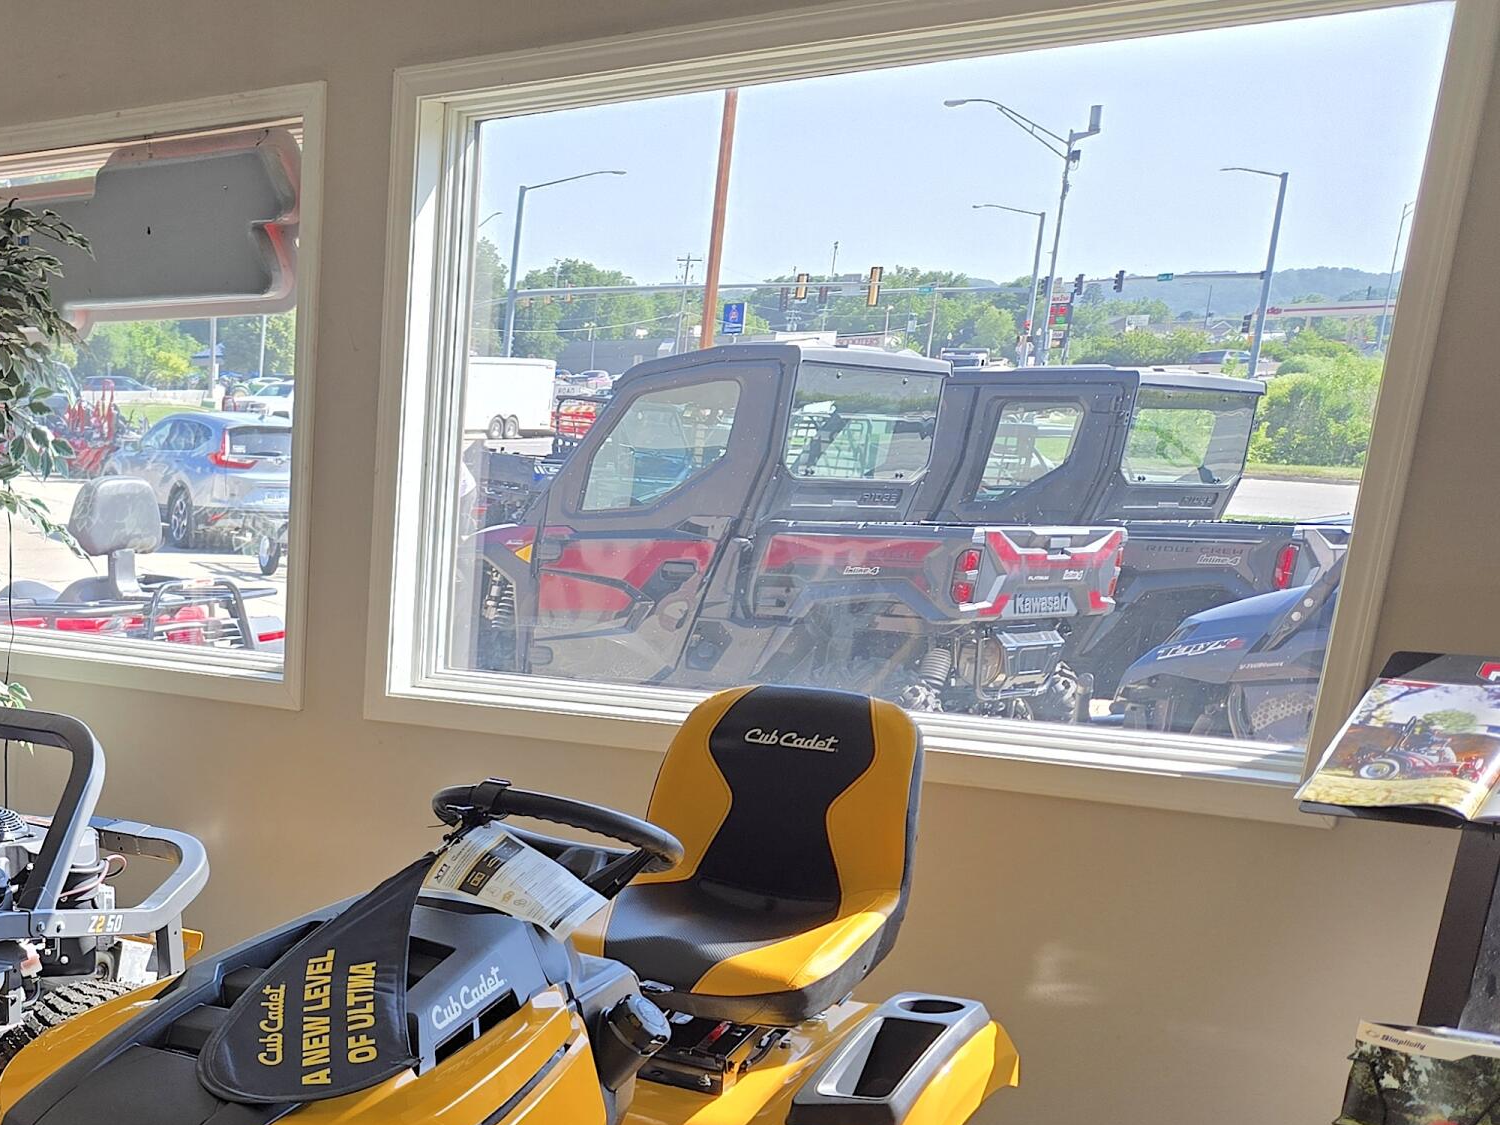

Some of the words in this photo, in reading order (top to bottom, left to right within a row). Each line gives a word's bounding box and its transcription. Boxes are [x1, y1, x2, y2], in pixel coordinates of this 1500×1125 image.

[744, 728, 779, 745] Cub
[779, 732, 839, 752] Cadet
[87, 915, 106, 932] Z2
[106, 914, 123, 932] 50
[302, 948, 336, 1012] LEVEL
[346, 960, 377, 1031] ULTIMA
[431, 996, 462, 1030] Cub
[460, 965, 506, 1010] Cadet
[259, 983, 287, 1032] Cadet
[257, 1033, 284, 1066] Cub
[302, 1016, 331, 1067] NEW
[347, 1034, 378, 1064] OF
[301, 1067, 332, 1086] A
